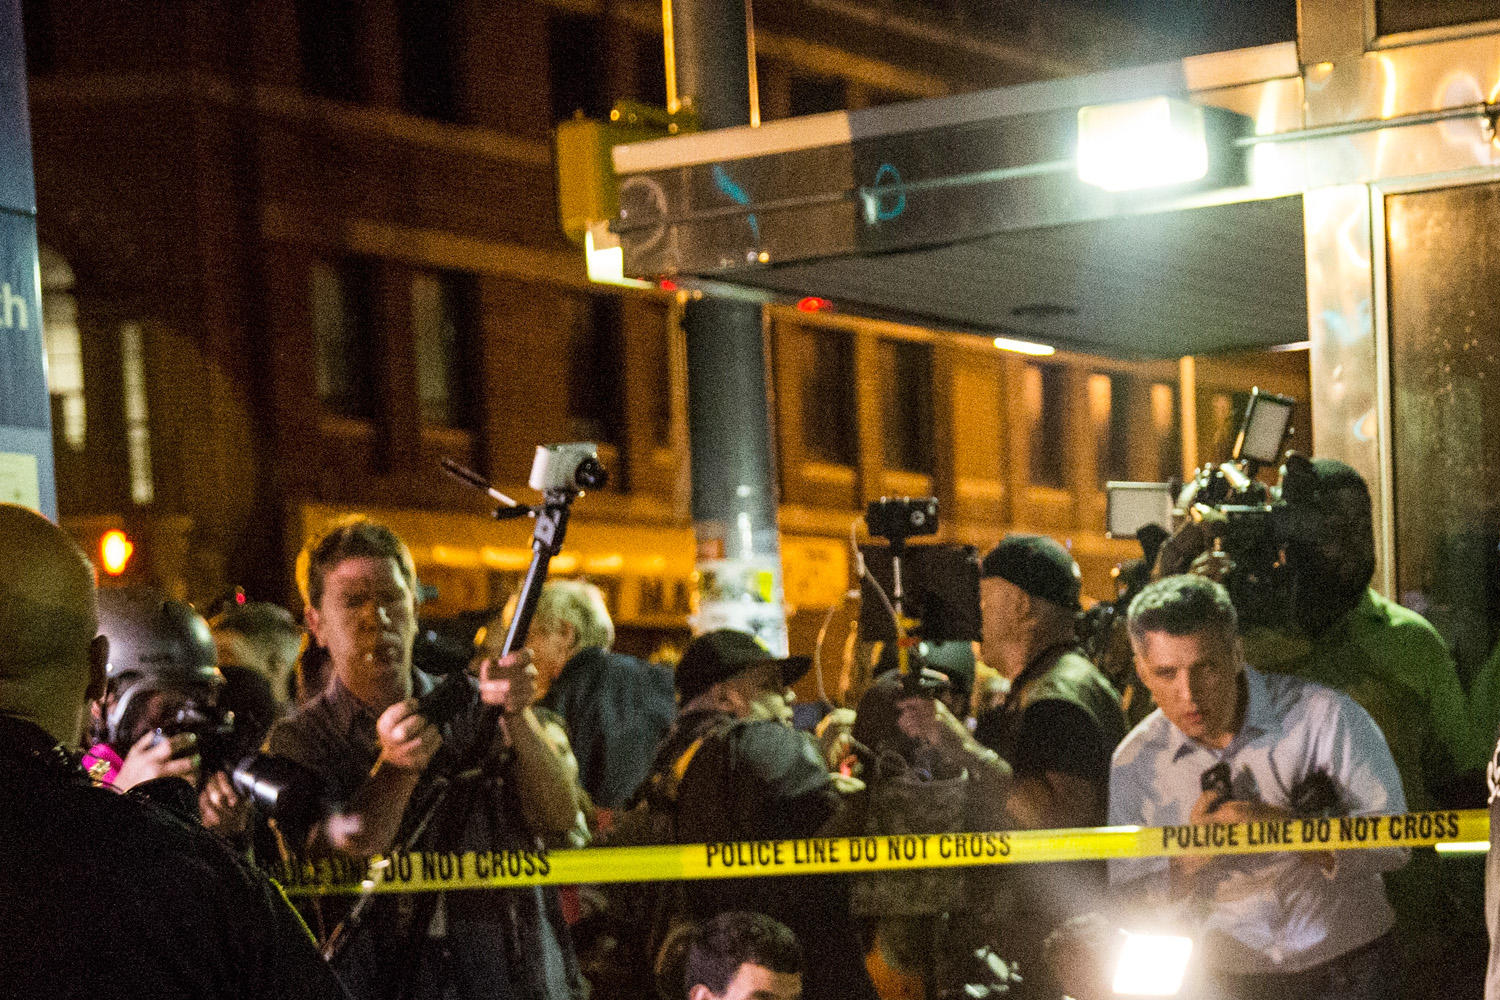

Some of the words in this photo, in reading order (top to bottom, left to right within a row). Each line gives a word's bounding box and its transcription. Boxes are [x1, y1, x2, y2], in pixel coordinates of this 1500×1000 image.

[1161, 822, 1239, 849] POLICE
[1247, 819, 1293, 845] LINE
[1301, 818, 1331, 843] DO
[1340, 816, 1381, 842] NOT
[1388, 812, 1459, 840] CROSS
[422, 851, 464, 882] NOT
[475, 849, 549, 880] CROSS
[706, 841, 783, 867] POLICE
[793, 838, 839, 864] LINE
[849, 836, 878, 862] DO
[888, 834, 930, 860] NOT
[938, 832, 1011, 859] CROSS
